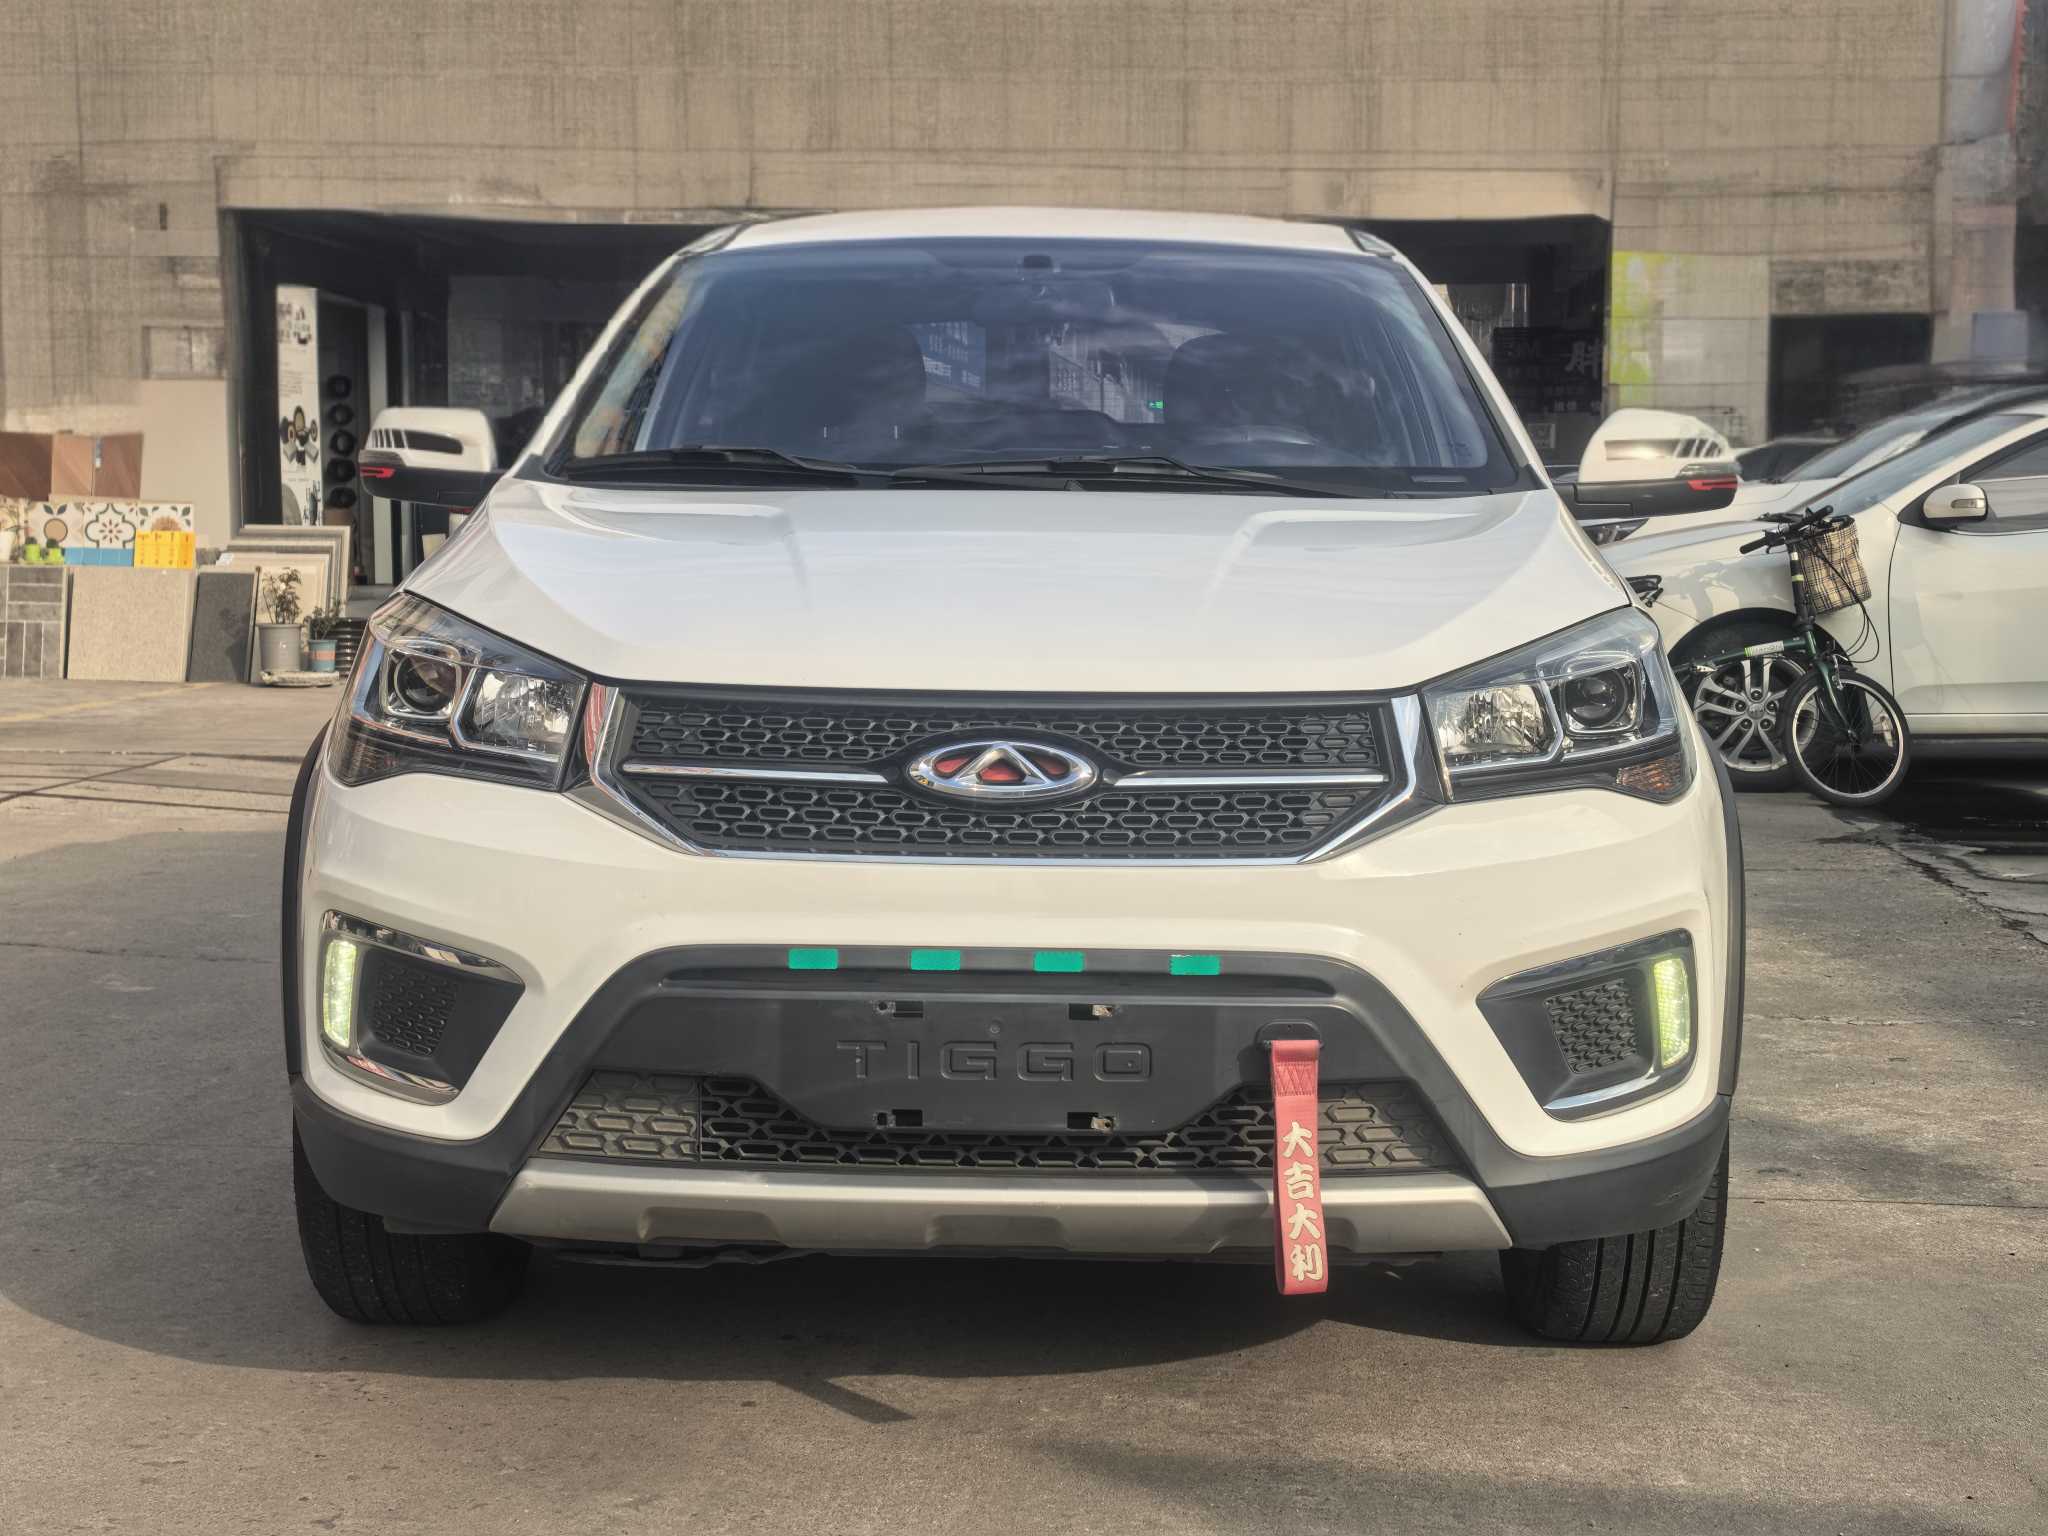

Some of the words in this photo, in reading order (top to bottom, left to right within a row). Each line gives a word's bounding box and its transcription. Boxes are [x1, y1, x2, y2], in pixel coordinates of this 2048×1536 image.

[836, 1040, 1153, 1082] TIGGO
[1281, 1120, 1326, 1282] 大吉大利
